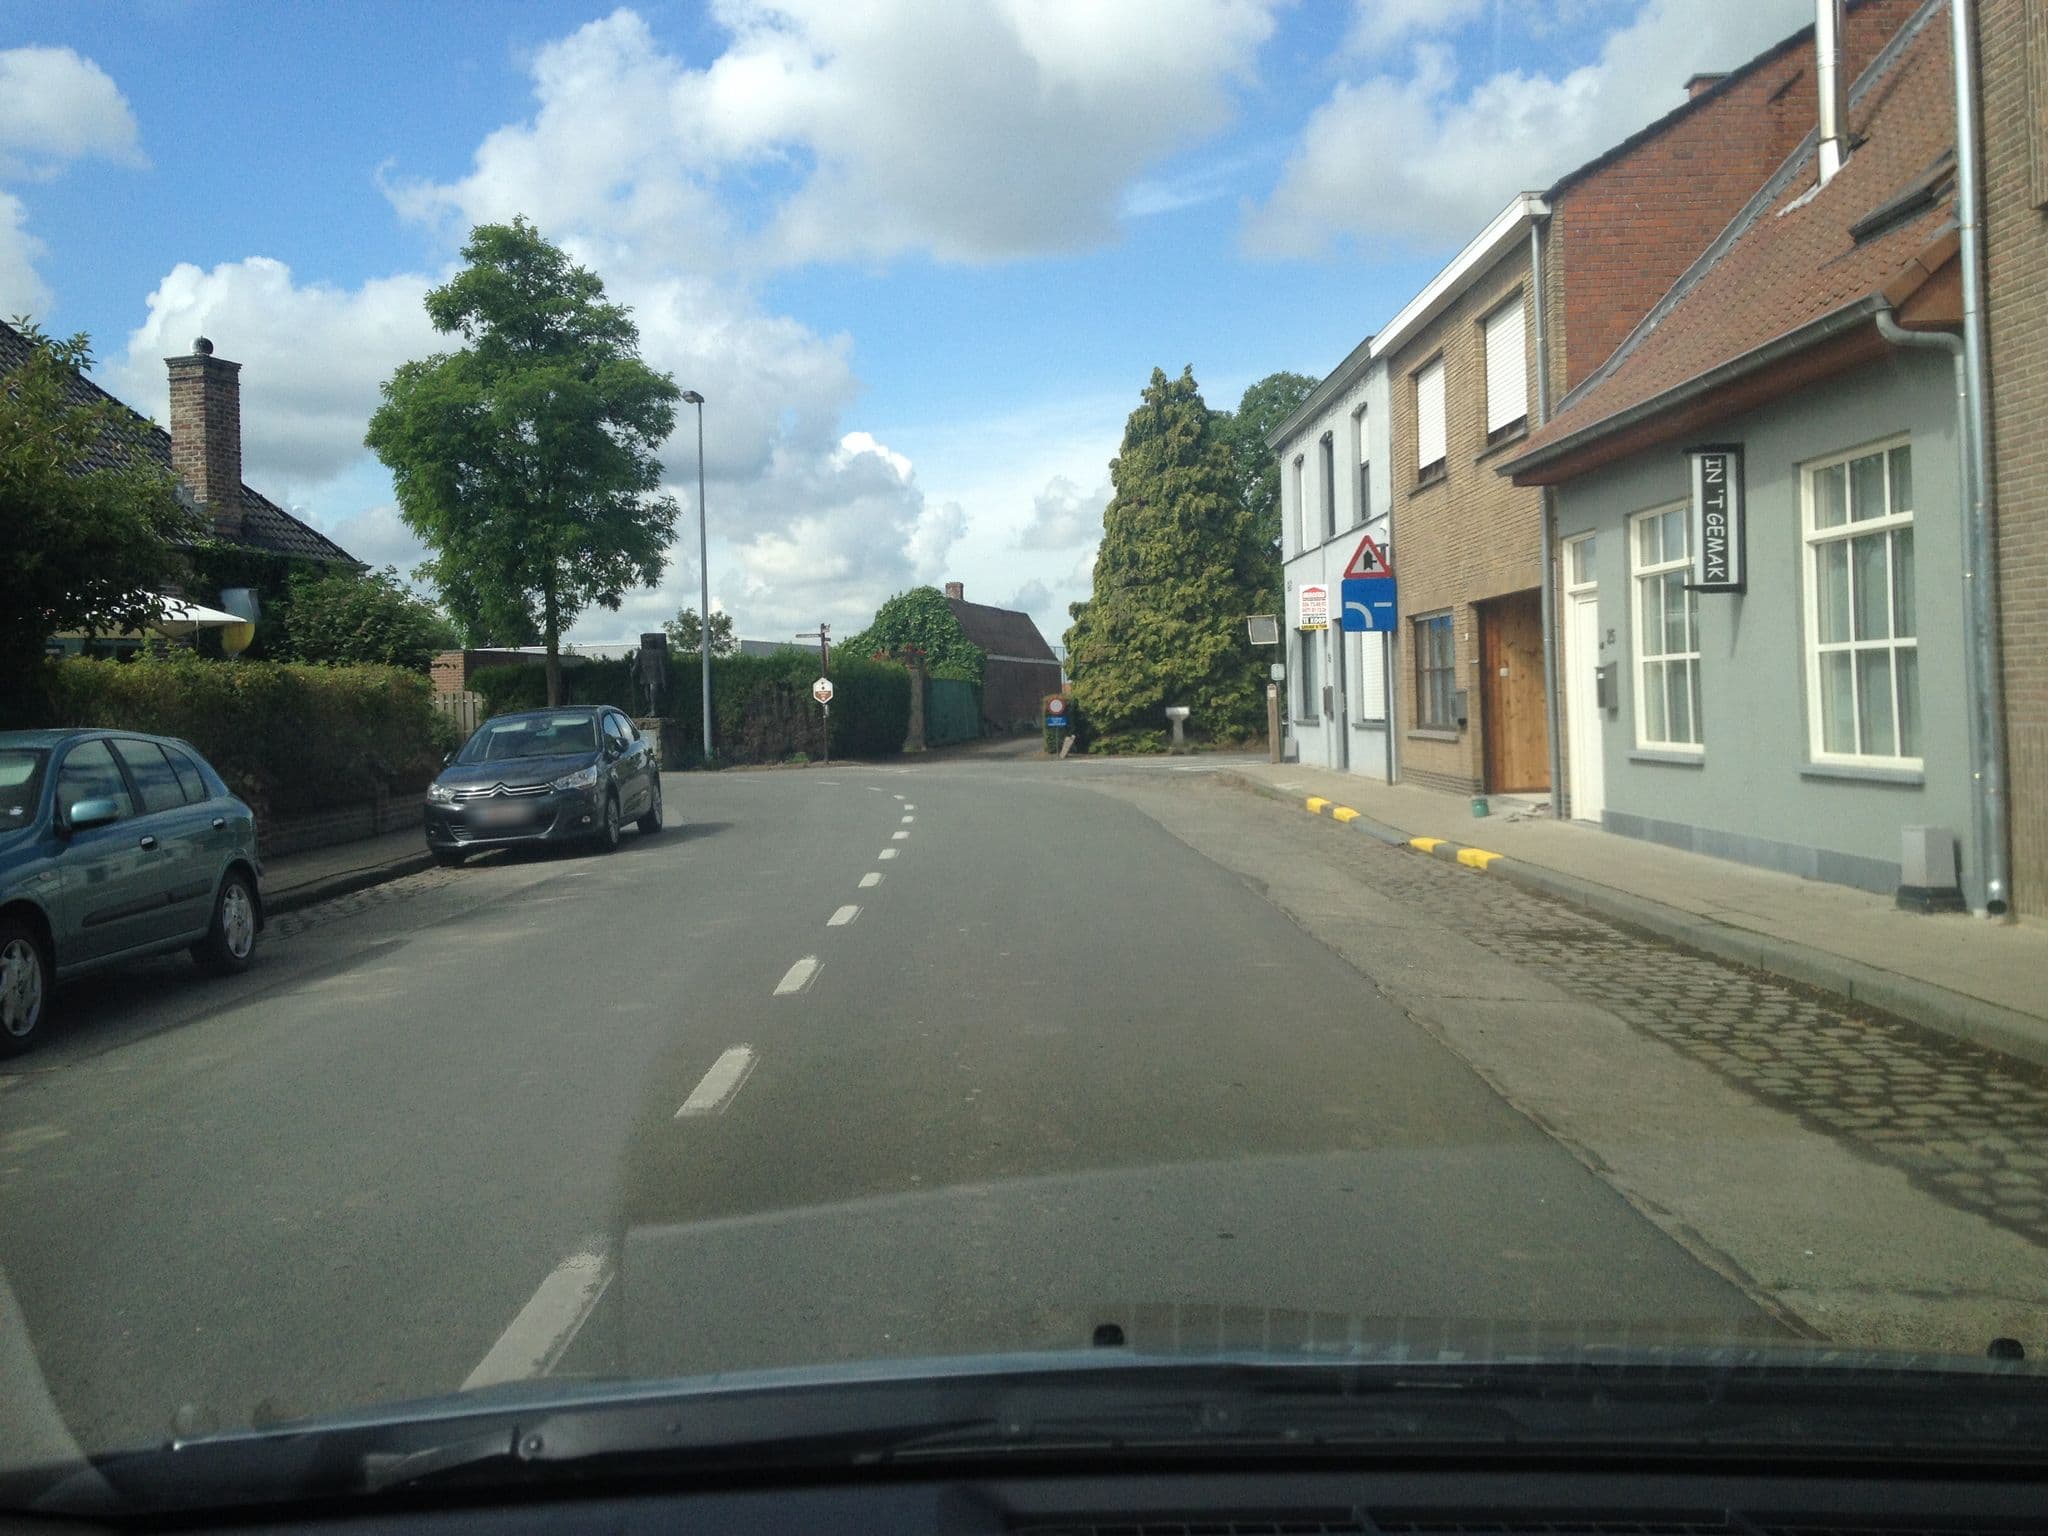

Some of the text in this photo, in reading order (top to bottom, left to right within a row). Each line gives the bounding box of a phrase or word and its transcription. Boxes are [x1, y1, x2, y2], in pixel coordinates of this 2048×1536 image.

[1705, 459, 1725, 578] IN 'T GEMAK
